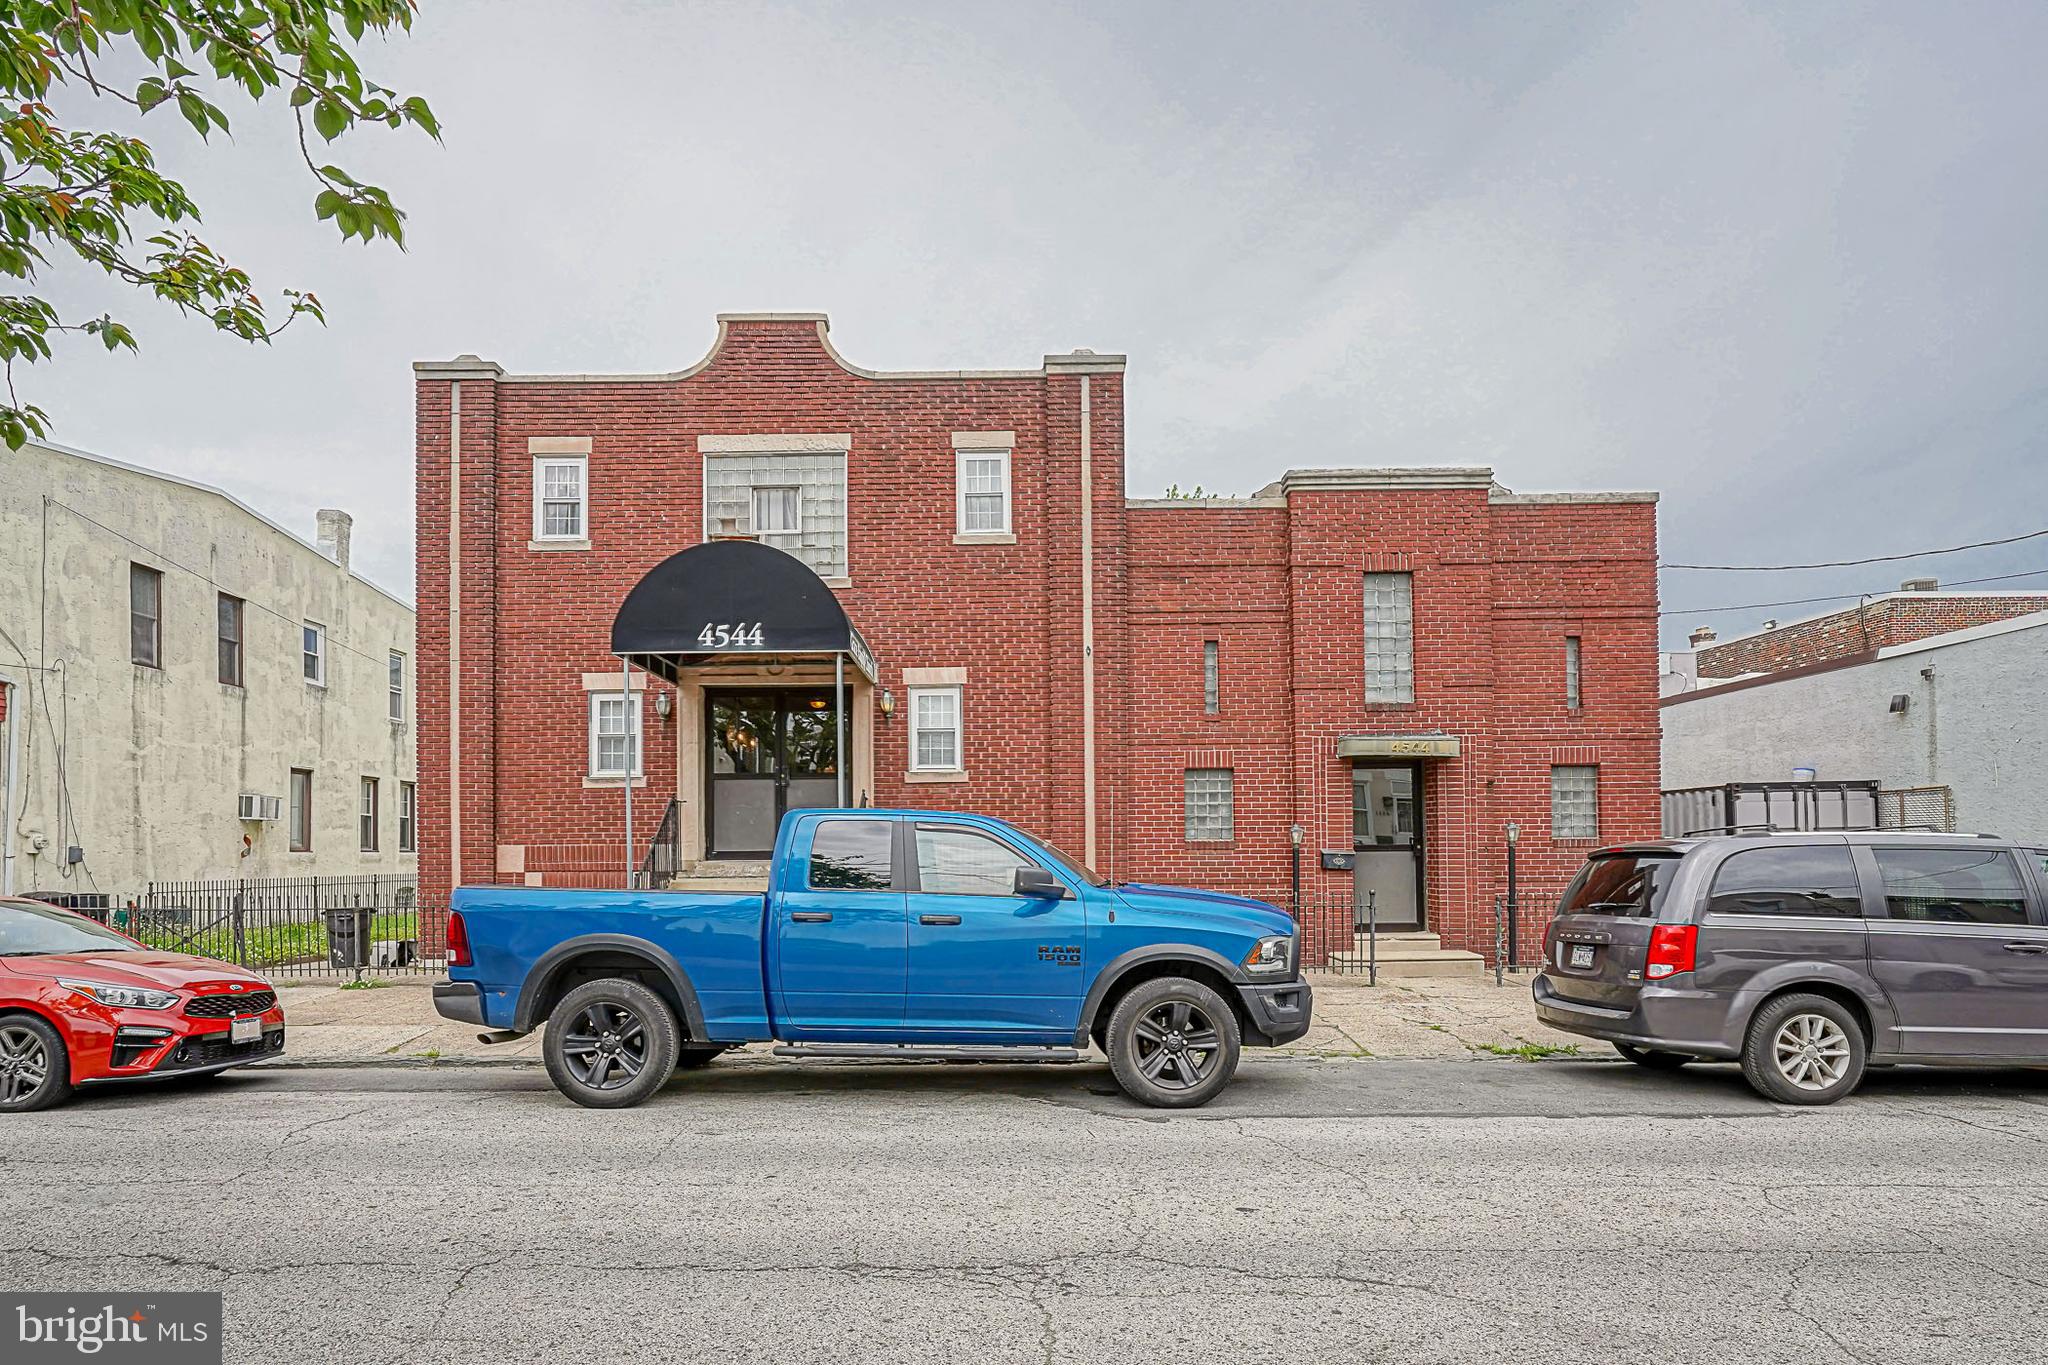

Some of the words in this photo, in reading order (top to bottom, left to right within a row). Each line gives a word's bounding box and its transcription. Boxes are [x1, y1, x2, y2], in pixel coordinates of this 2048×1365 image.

[697, 622, 765, 648] 4544
[1391, 741, 1431, 753] 4544
[1038, 945, 1081, 954] RAM
[1038, 953, 1081, 961] 1500
